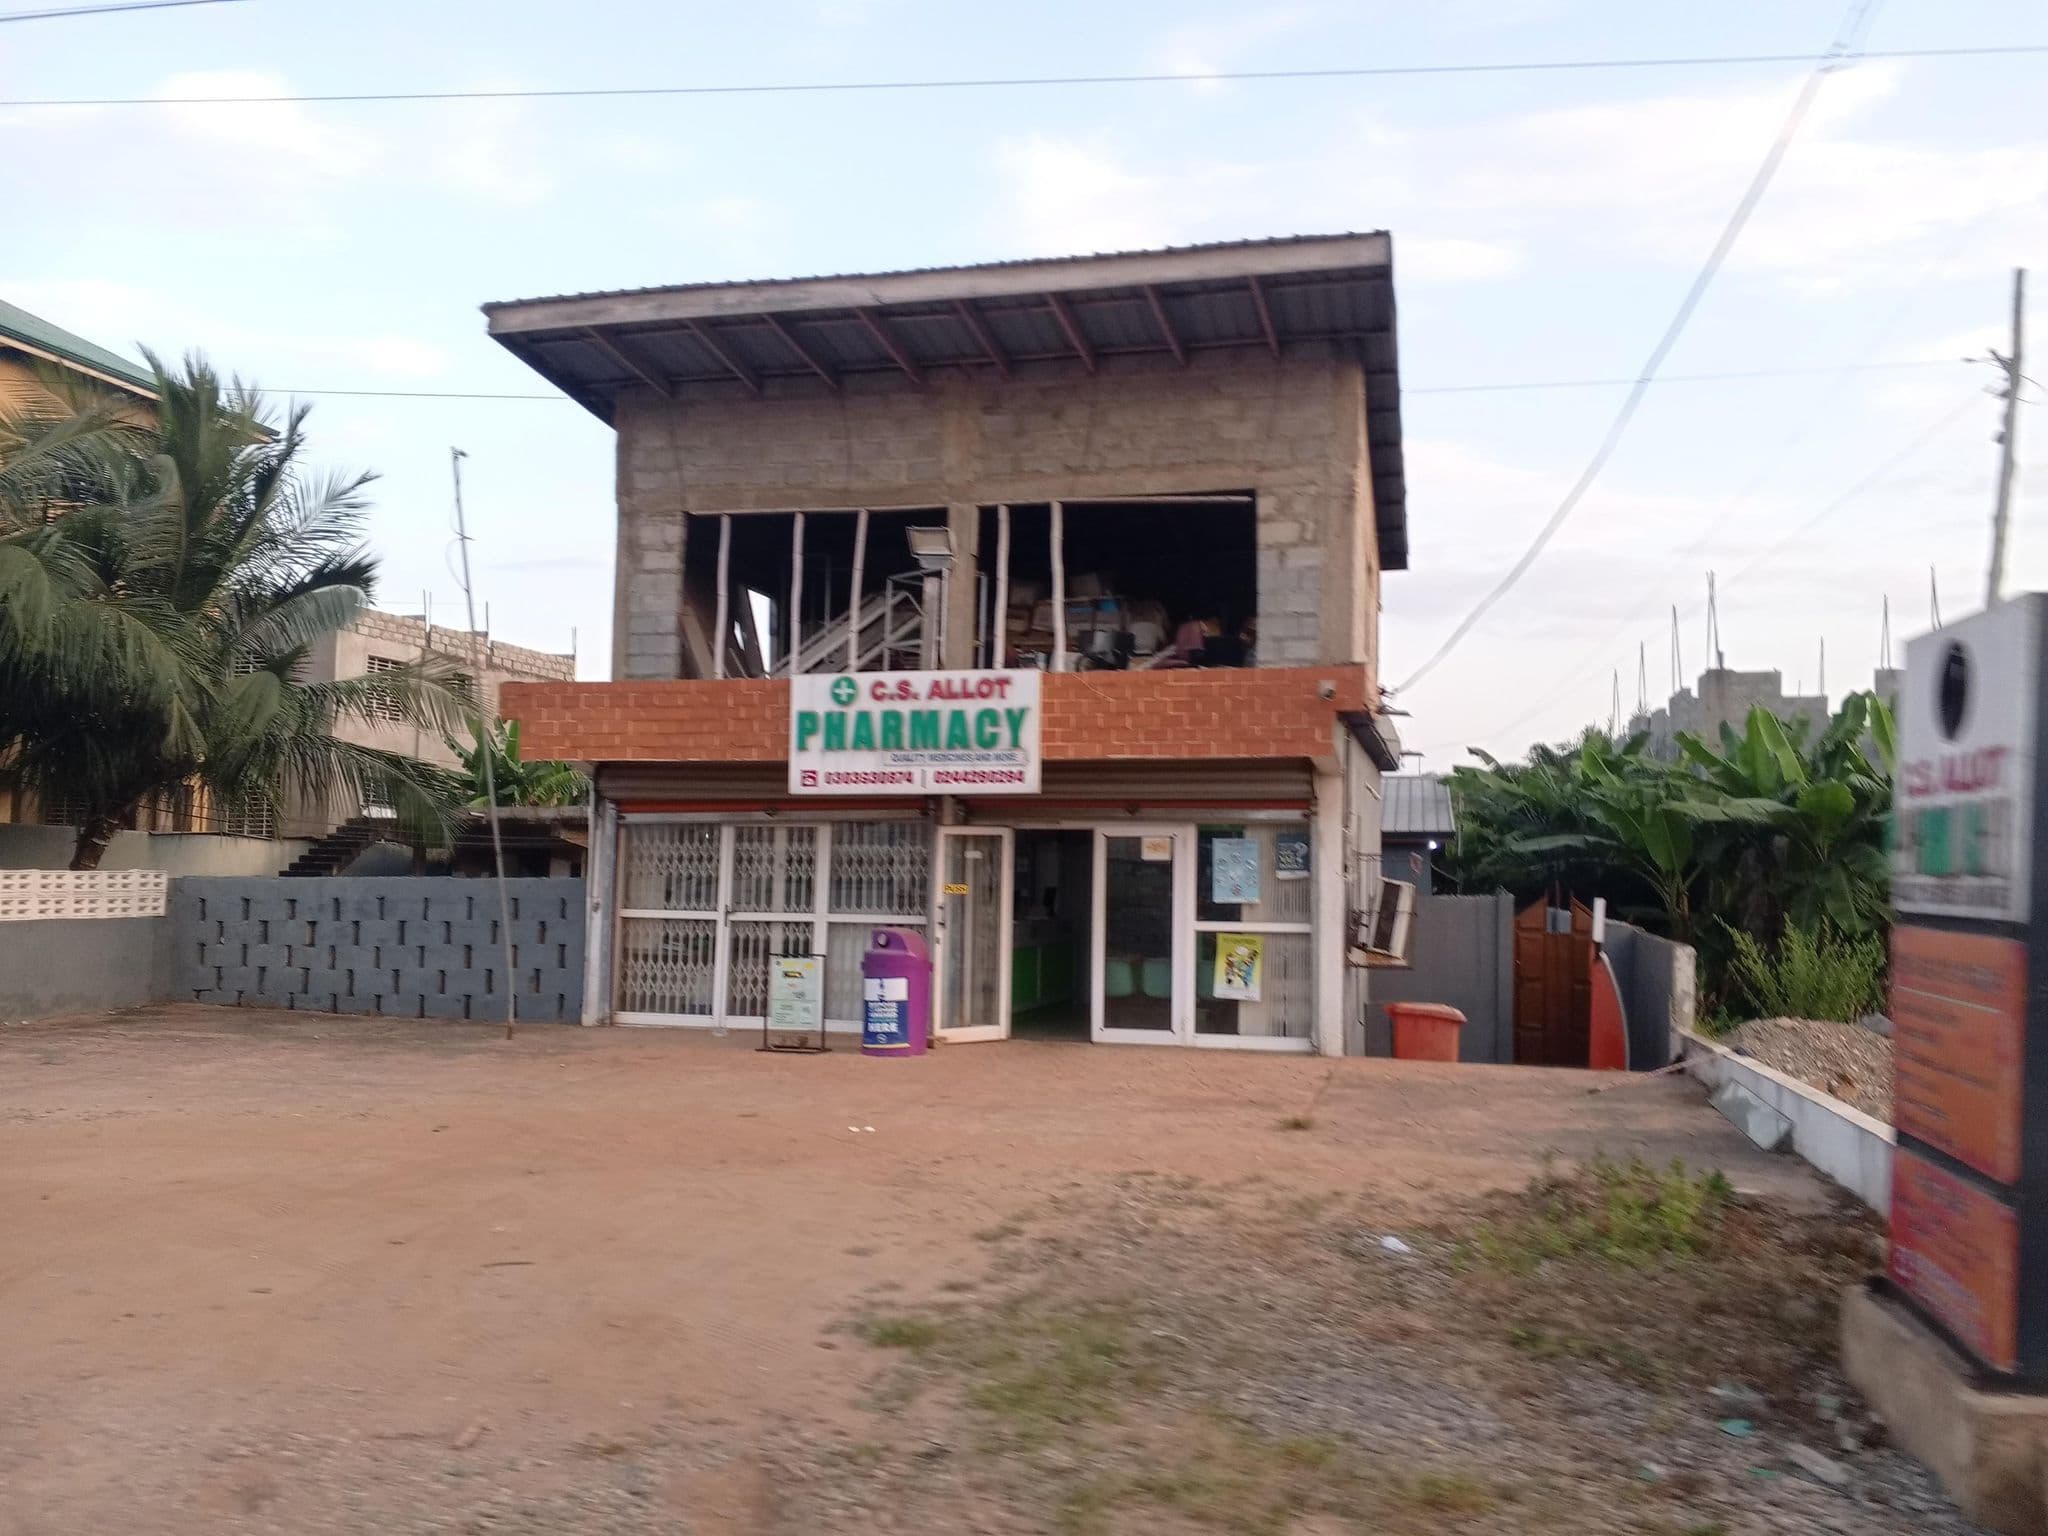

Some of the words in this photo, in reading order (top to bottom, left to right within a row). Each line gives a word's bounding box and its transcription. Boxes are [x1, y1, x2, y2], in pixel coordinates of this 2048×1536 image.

[870, 680, 919, 701] C.S.
[927, 677, 1012, 700] ALLOT
[797, 707, 1029, 751] PHARMACY
